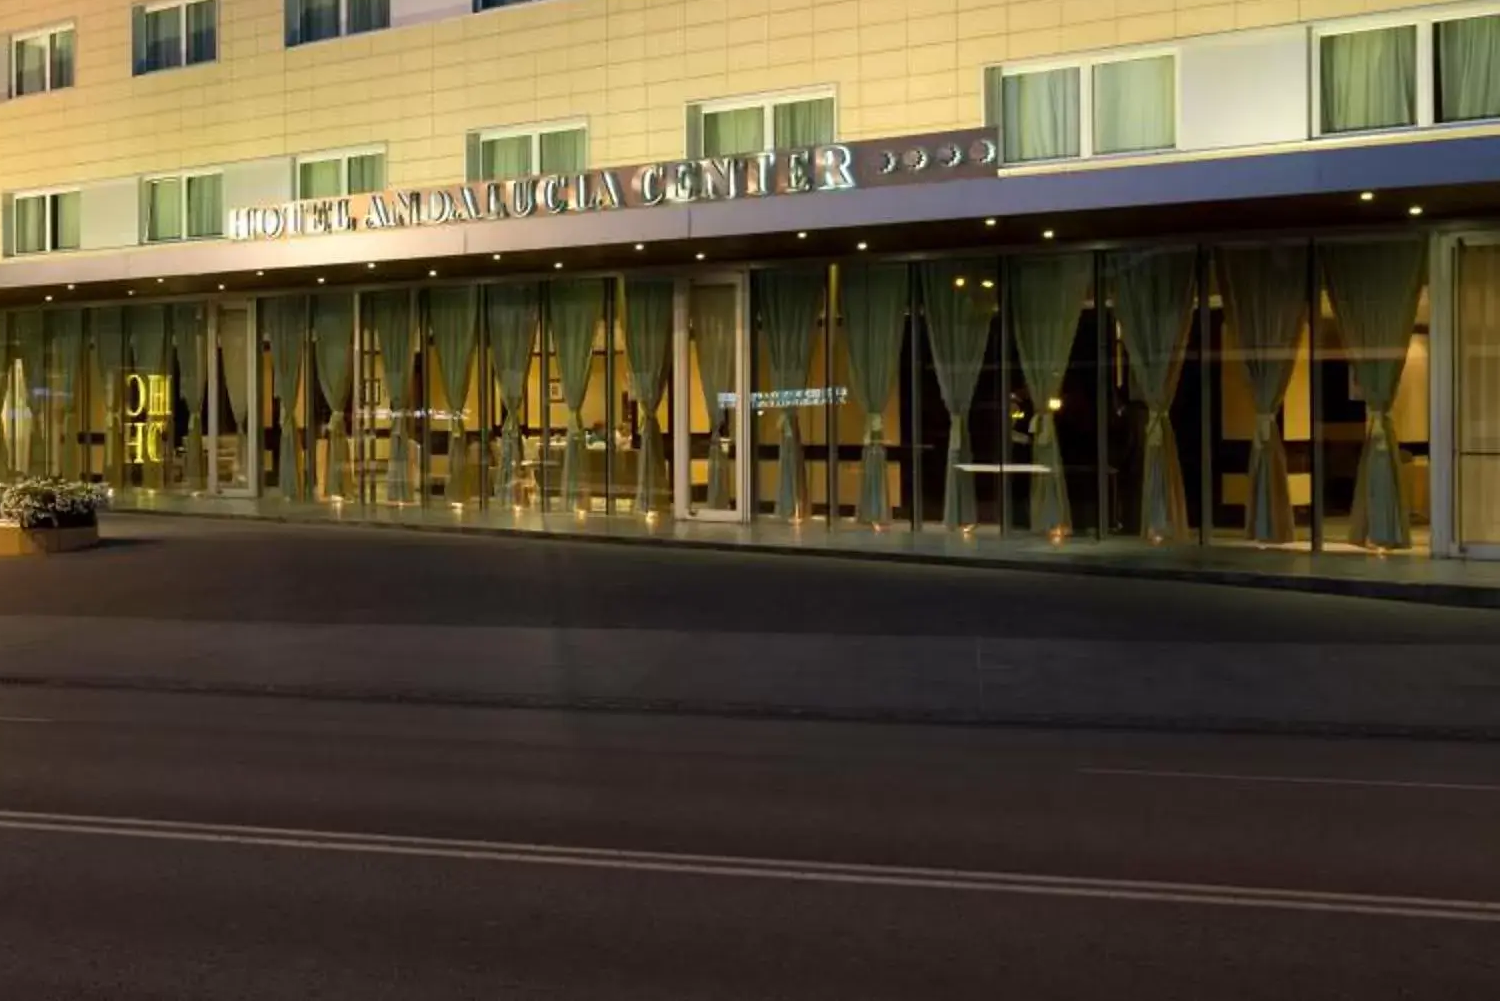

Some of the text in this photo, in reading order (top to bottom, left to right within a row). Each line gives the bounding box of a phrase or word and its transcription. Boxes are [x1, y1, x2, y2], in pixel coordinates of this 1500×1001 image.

[231, 145, 855, 241] HOTEL ANDALUCIA CENTER
